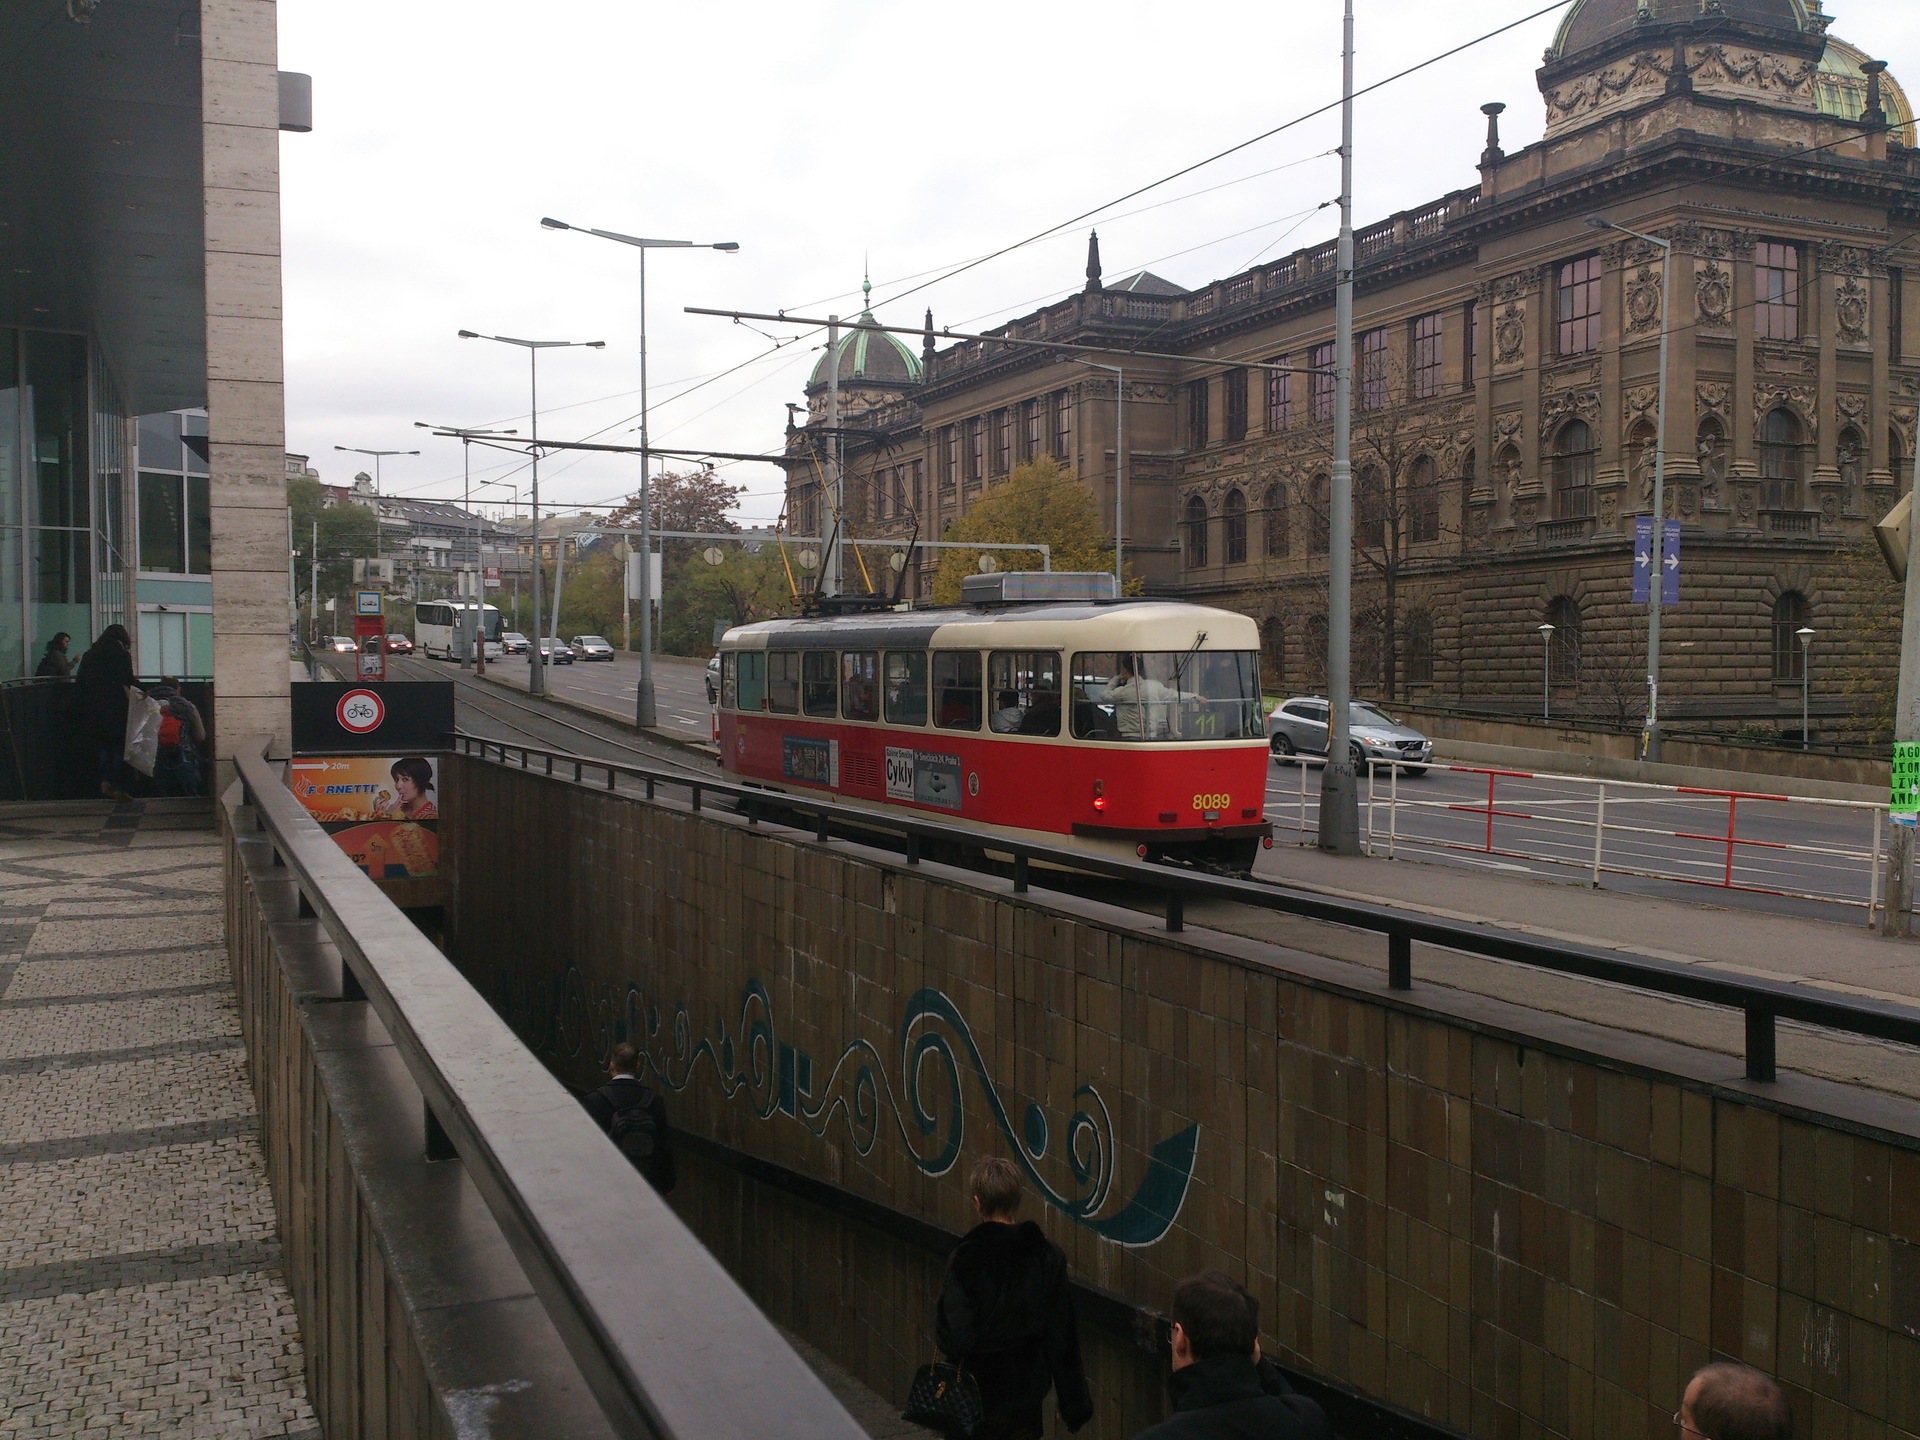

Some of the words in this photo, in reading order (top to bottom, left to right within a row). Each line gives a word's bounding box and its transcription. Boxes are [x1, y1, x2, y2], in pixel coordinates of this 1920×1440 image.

[1195, 714, 1216, 735] 11
[331, 762, 349, 770] 20m
[886, 758, 913, 788] Cykly
[308, 784, 376, 795] FORNETTI
[1192, 793, 1231, 810] 8089
